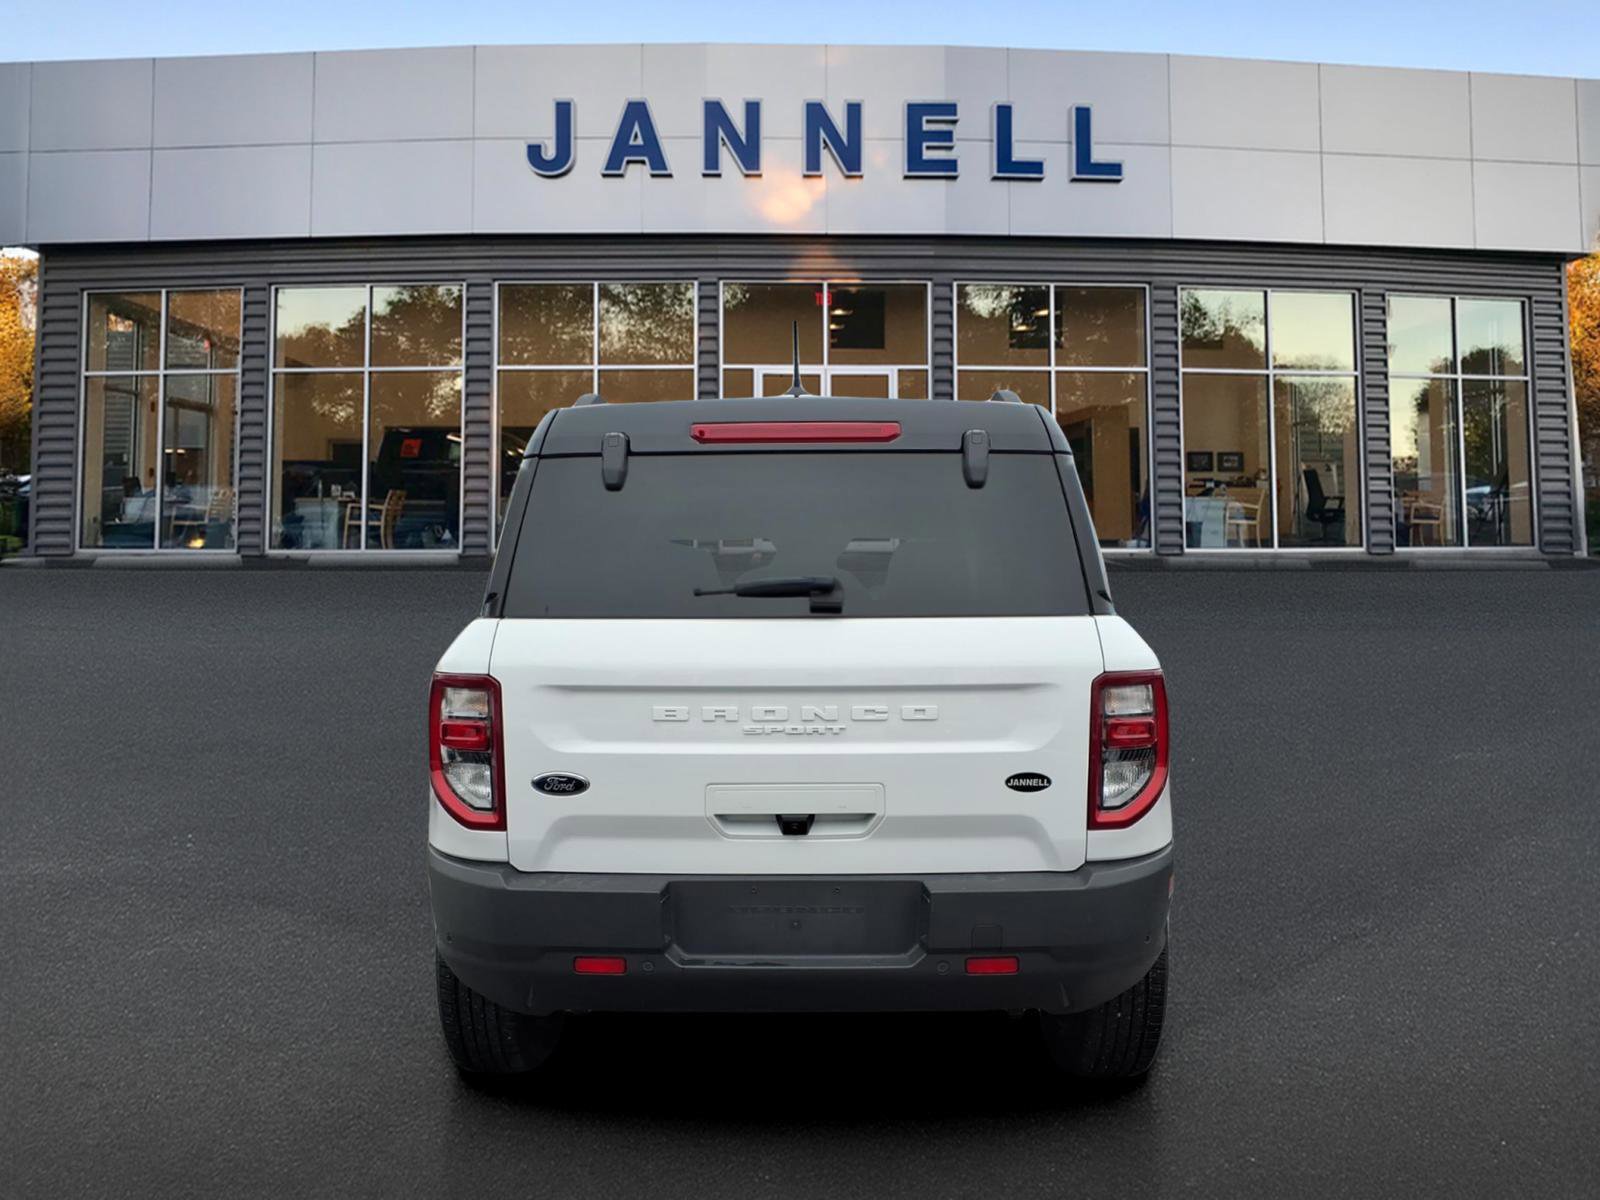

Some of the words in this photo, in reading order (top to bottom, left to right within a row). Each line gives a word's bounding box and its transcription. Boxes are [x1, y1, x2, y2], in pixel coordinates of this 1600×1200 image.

[526, 98, 1124, 181] JANNELL
[652, 705, 939, 722] BRONCO
[743, 725, 846, 736] SPORT
[543, 776, 576, 791] Ford
[1007, 778, 1050, 787] JANNELL
